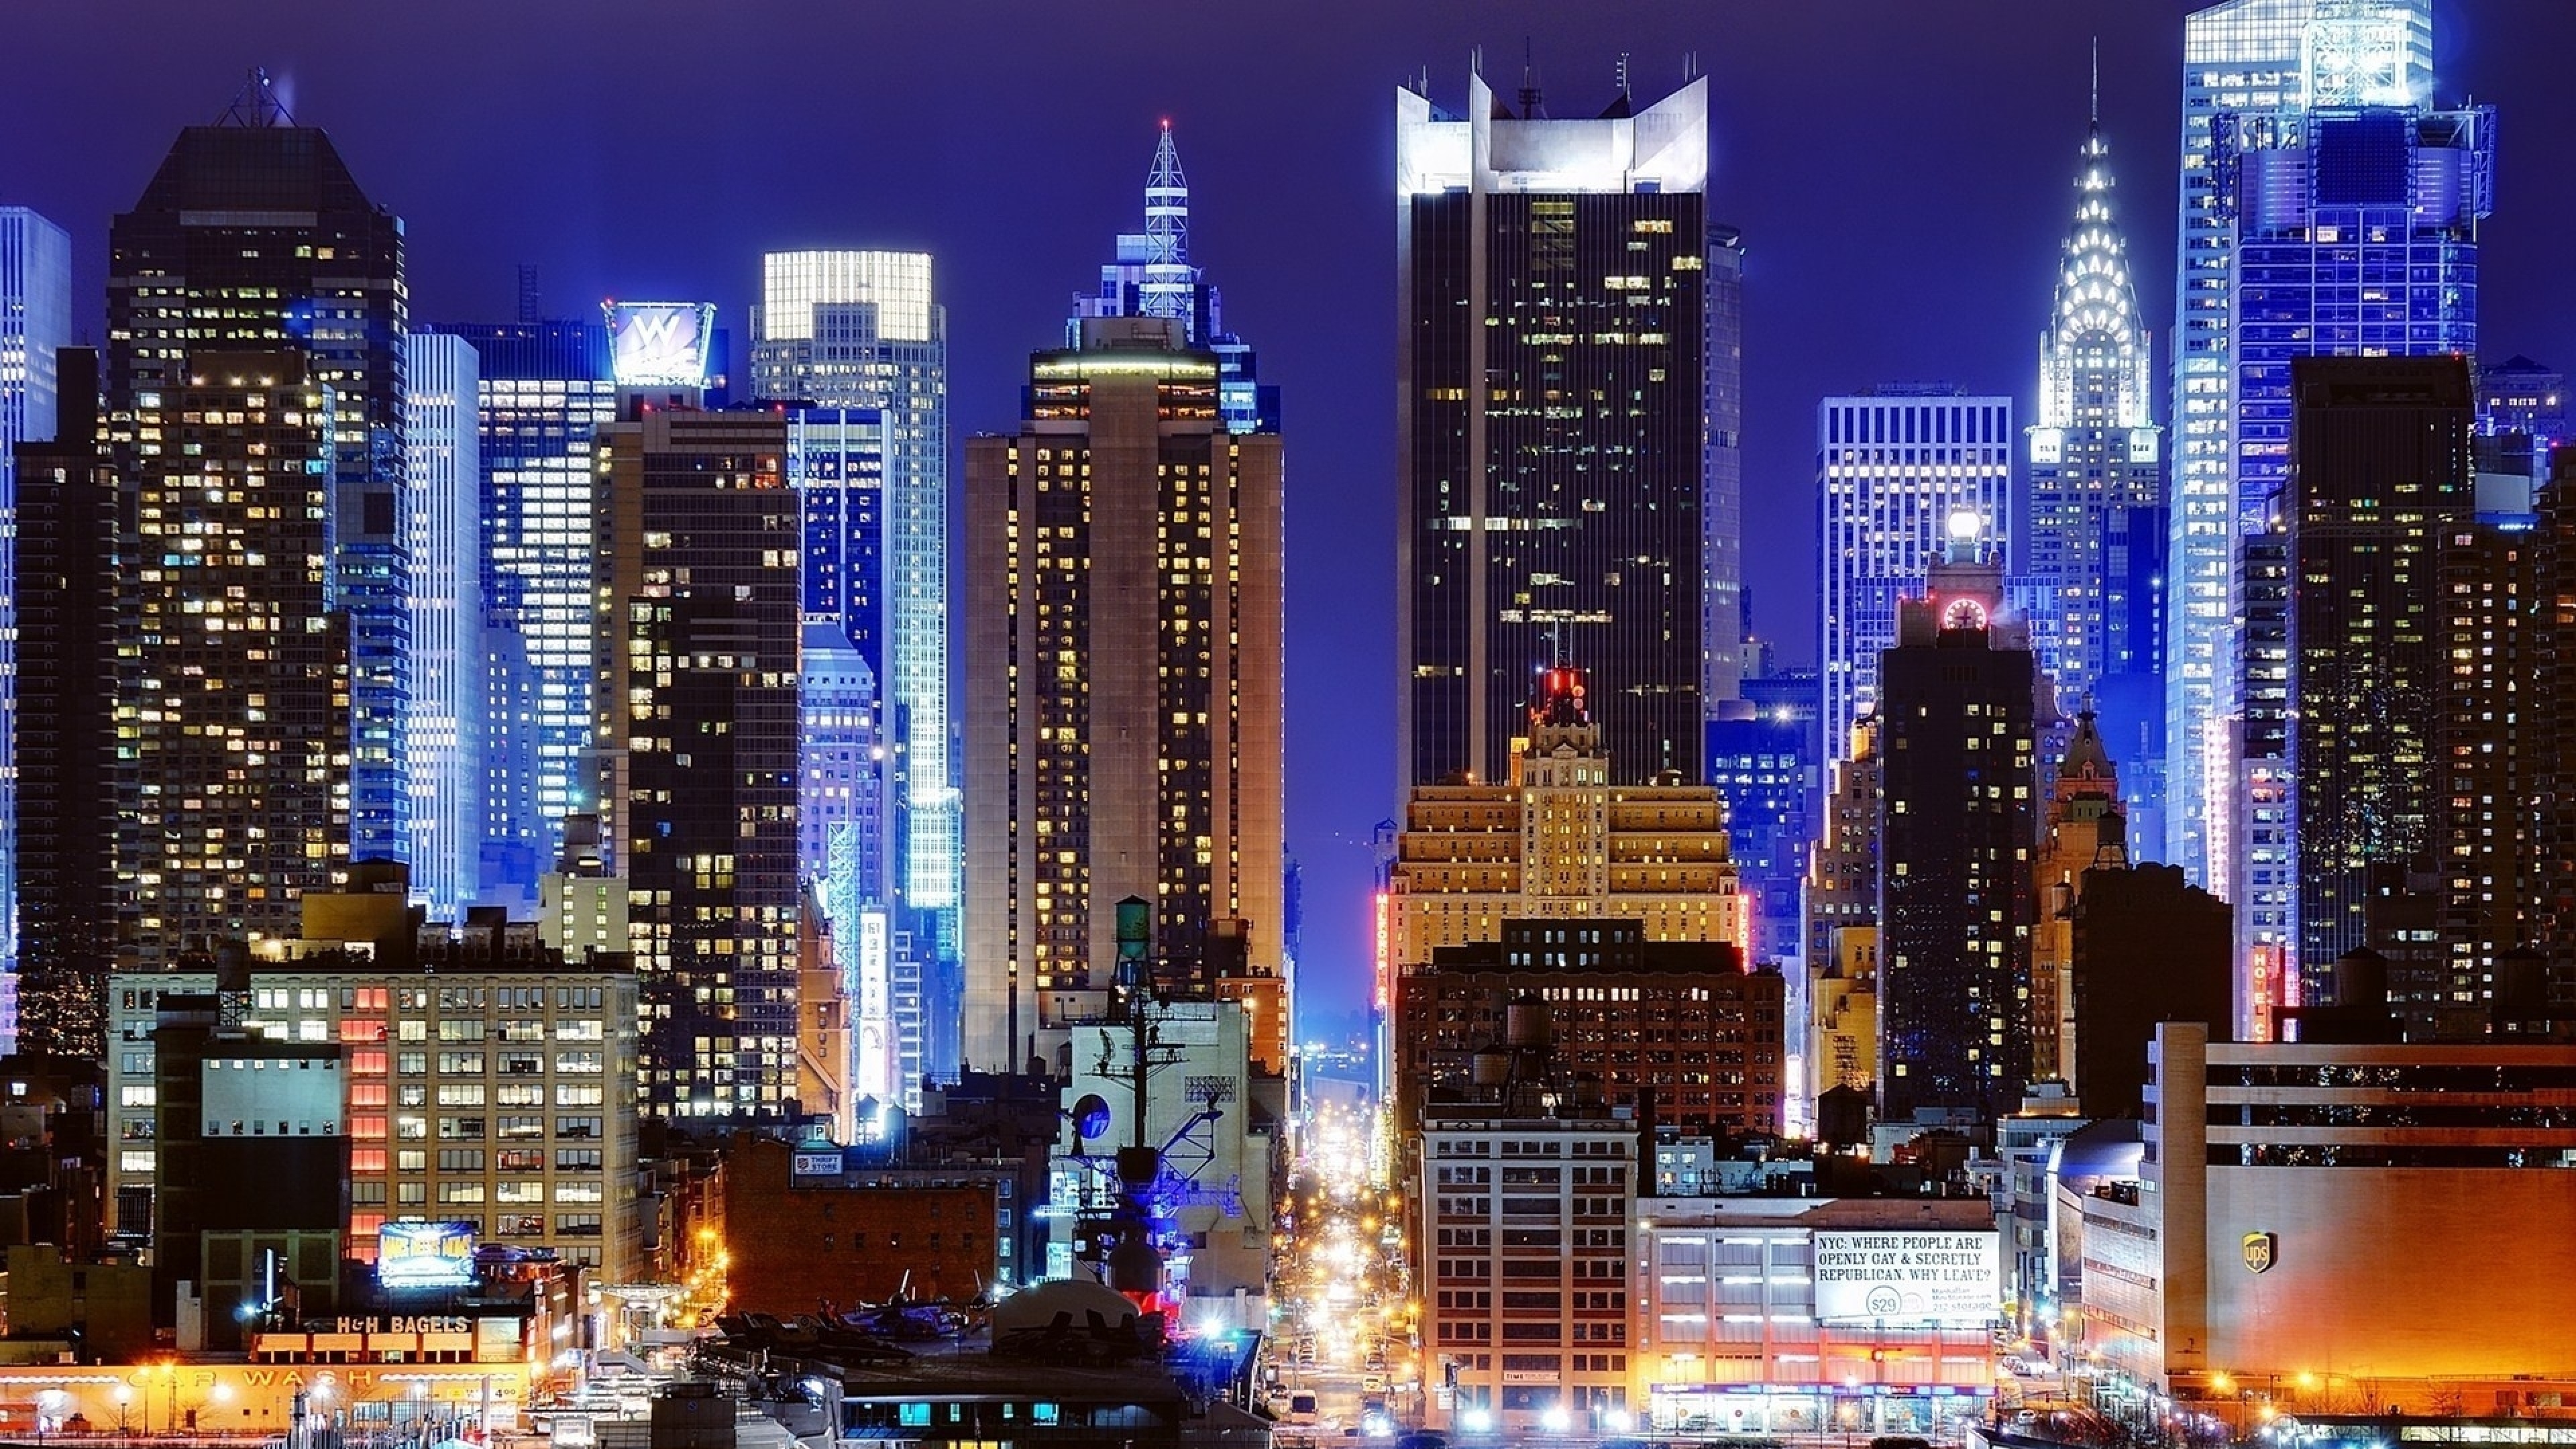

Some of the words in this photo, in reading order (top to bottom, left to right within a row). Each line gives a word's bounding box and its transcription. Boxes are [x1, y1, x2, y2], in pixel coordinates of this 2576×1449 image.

[632, 315, 681, 347] W
[2254, 953, 2265, 1016] HOTEL
[816, 1127, 824, 1136] P
[1819, 1237, 1847, 1249] NYC:
[1851, 1237, 1899, 1249] WHERE
[1902, 1237, 1952, 1249] PEOPLE
[1955, 1237, 1982, 1249] ARE
[1819, 1253, 1868, 1265] OPENLY
[1872, 1253, 1896, 1265] GAY
[1900, 1253, 1911, 1265] &
[1915, 1253, 1981, 1265] SECRETLY
[2245, 1246, 2268, 1267] ups
[1819, 1269, 1905, 1281] REPUBLICAN.
[1909, 1269, 1939, 1281] WHY
[1944, 1269, 1991, 1281] LEAVE?
[1871, 1299, 1896, 1312] $29
[337, 1316, 378, 1333] H&H
[391, 1316, 468, 1333] BAGELS
[127, 1371, 216, 1387] CAR
[243, 1370, 372, 1387] WASH
